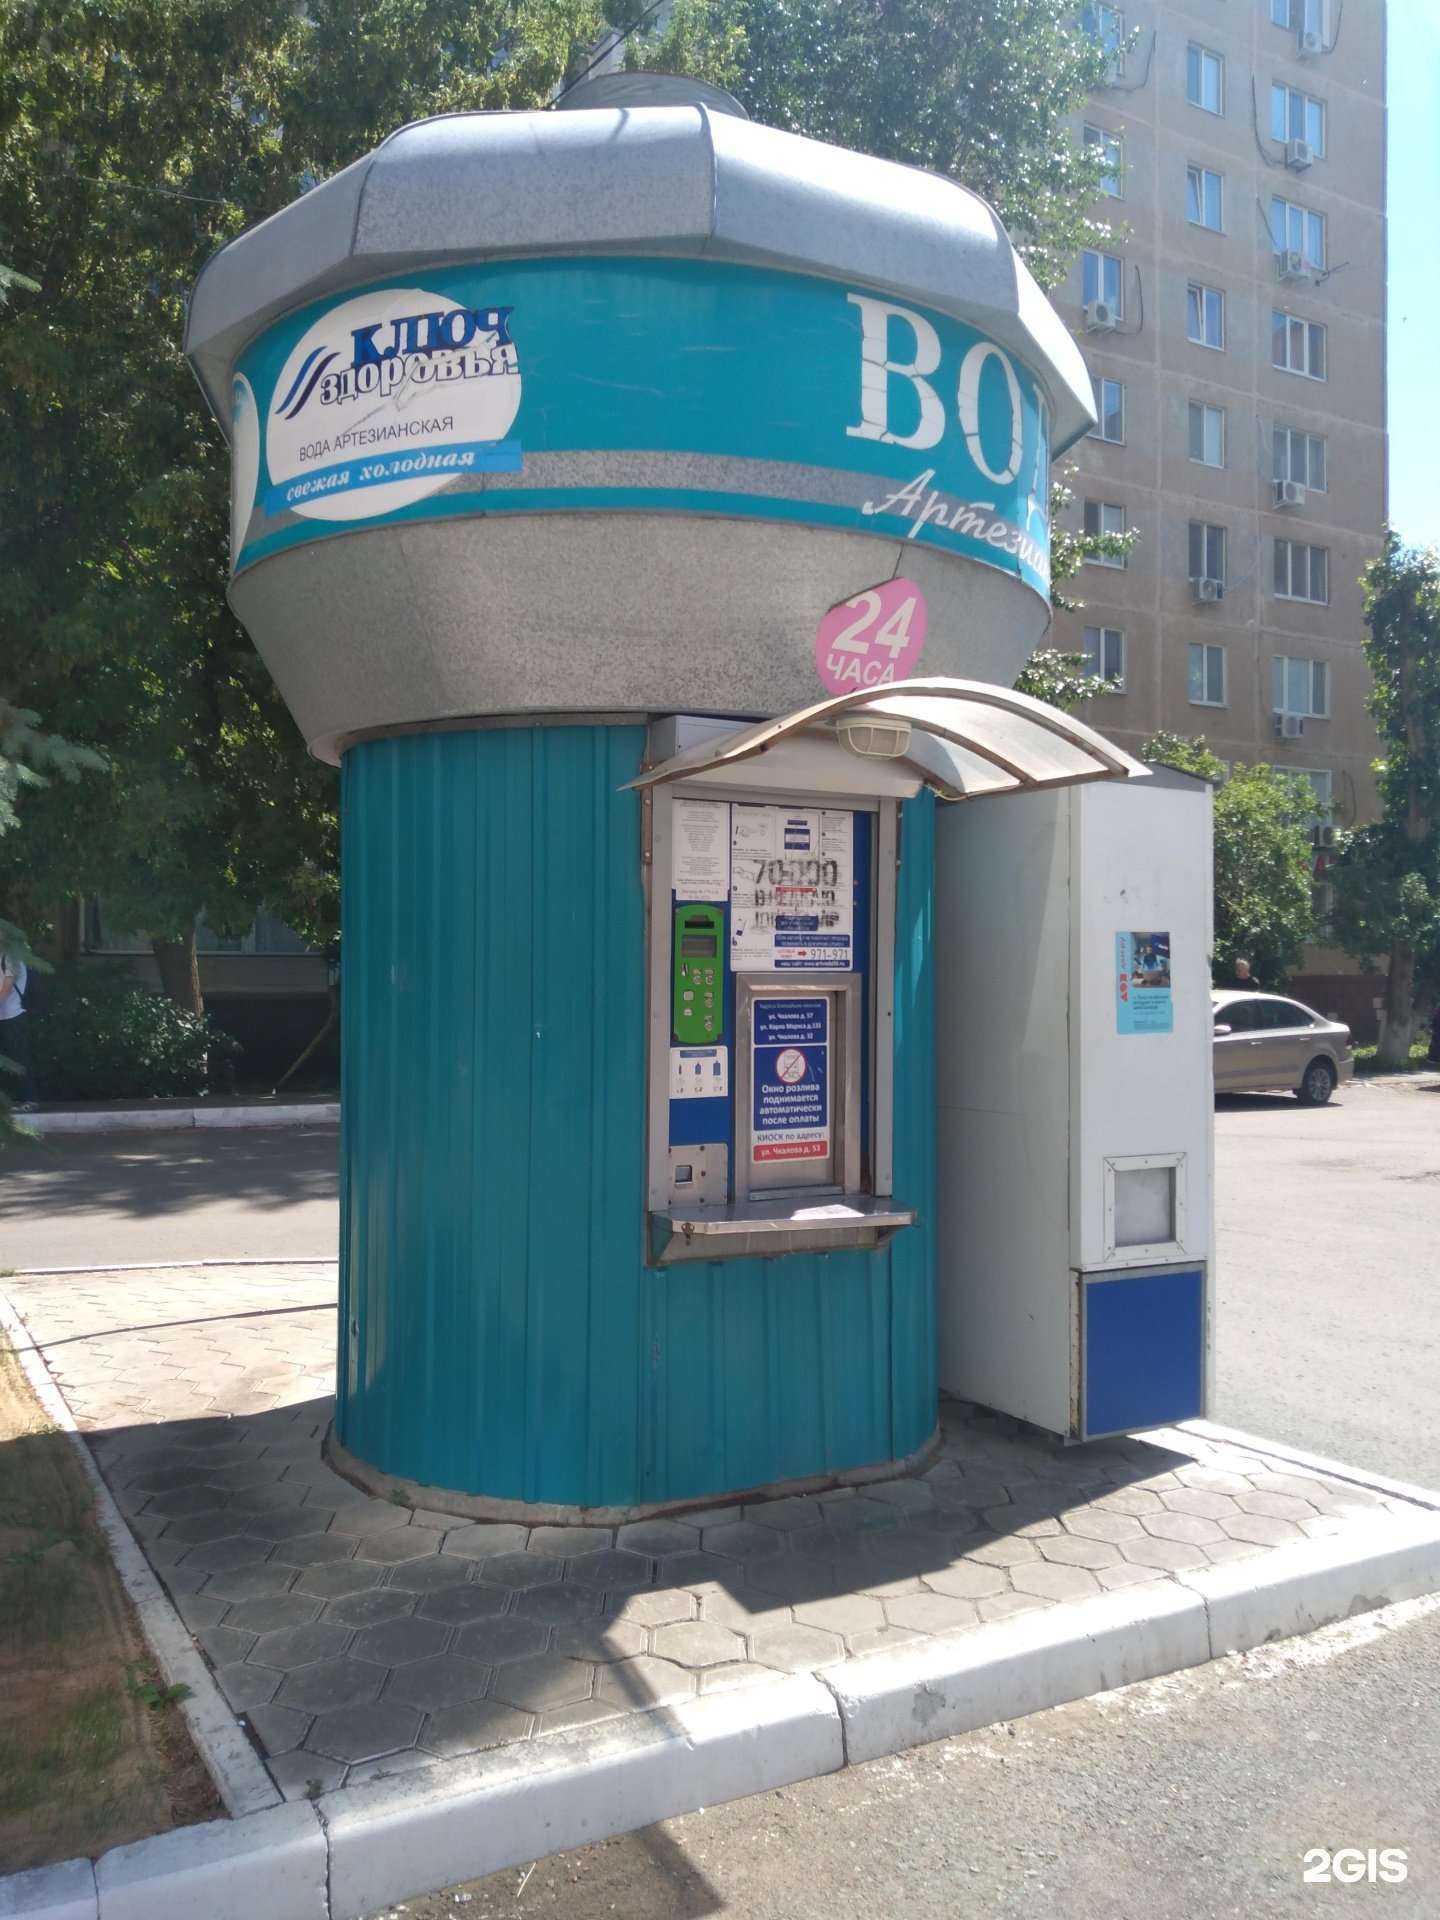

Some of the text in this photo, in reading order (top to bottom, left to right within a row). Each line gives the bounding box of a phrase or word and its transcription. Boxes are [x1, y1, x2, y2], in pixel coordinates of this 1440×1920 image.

[299, 416, 454, 462] ВОДА АРТЕЗИАНСКАЯ
[286, 451, 476, 502] свежая холодная
[832, 590, 917, 659] 24
[826, 653, 895, 686] ЧАСА
[762, 1083, 820, 1095] Окно розлива
[763, 1094, 819, 1105] поднимается
[759, 1104, 822, 1115] автоматически
[762, 1115, 820, 1125] после оплаты
